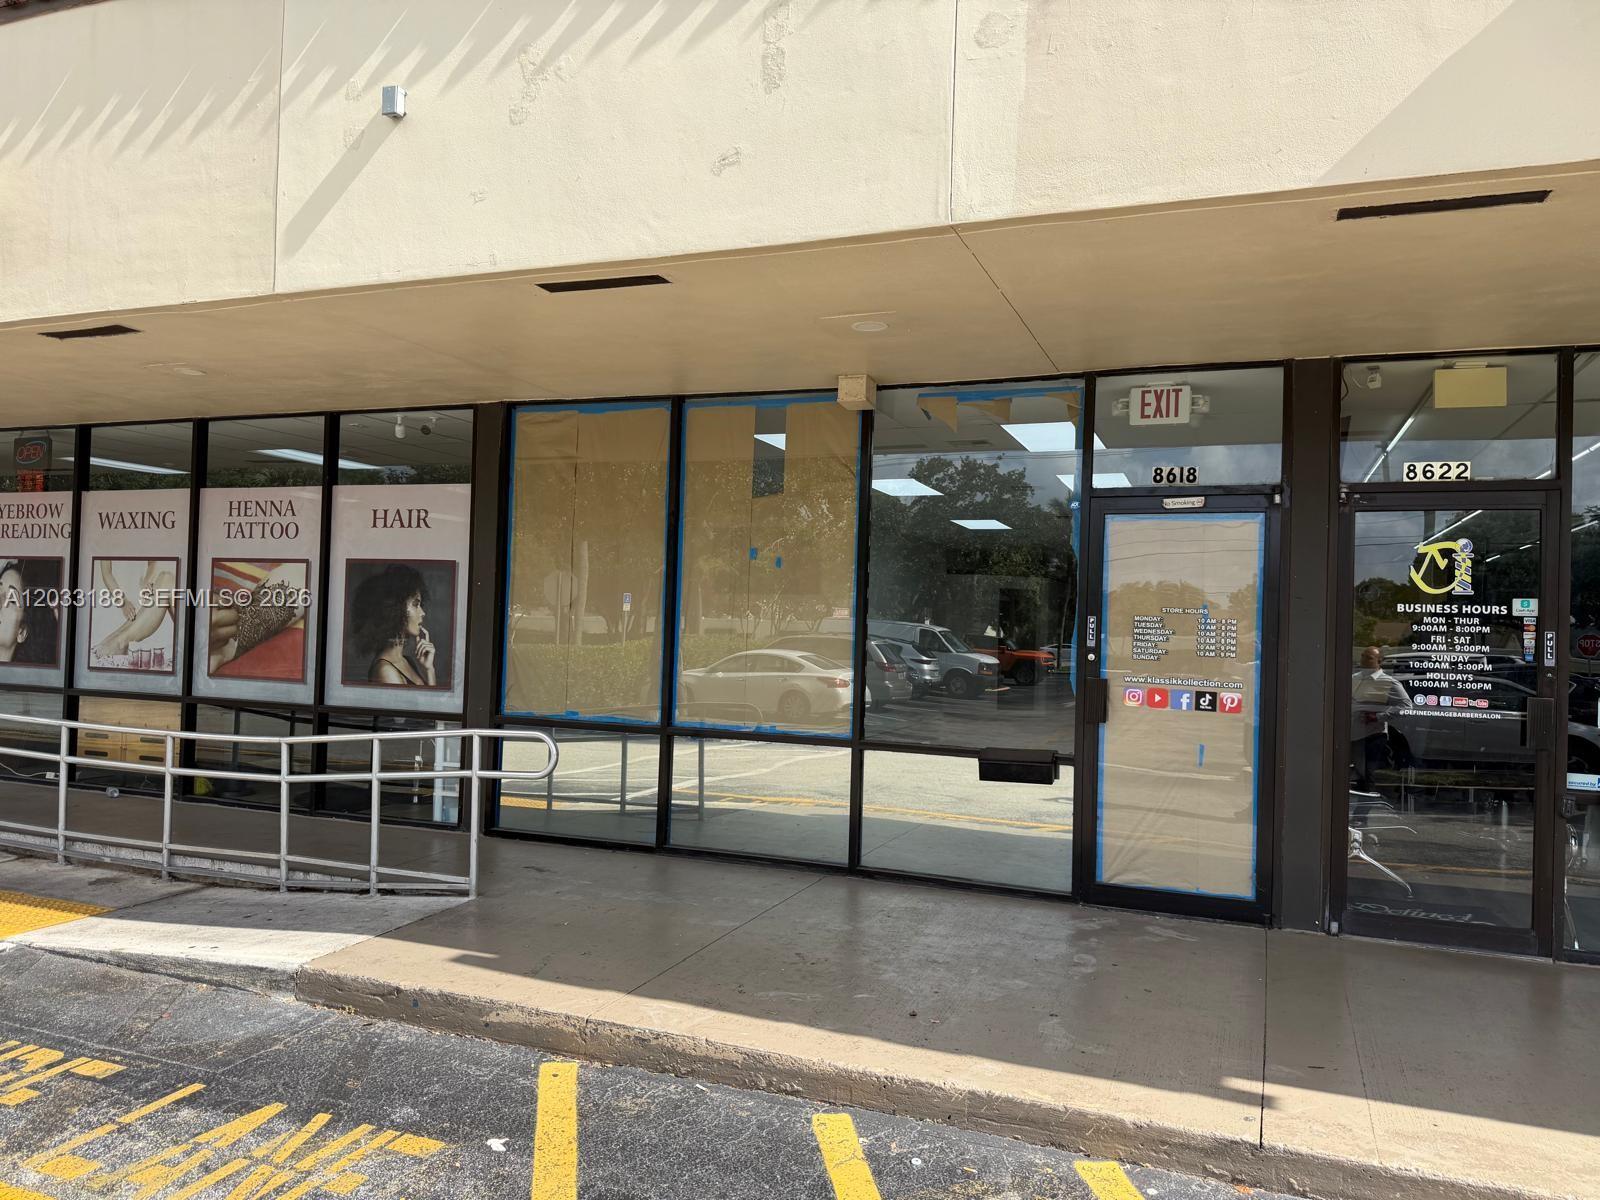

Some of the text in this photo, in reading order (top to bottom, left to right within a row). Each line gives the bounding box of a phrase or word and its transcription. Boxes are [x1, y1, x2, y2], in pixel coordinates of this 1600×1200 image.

[1139, 387, 1183, 420] EXIT
[1152, 466, 1198, 484] 8618
[1405, 462, 1469, 481] 8622
[228, 499, 297, 517] HENNA
[1171, 499, 1195, 508] Smoking
[97, 510, 176, 530] WAXING
[370, 507, 432, 529] HAIR
[223, 521, 300, 540] TATTOO
[1396, 603, 1508, 615] BUSINESS HOURS
[1423, 616, 1446, 624] MON
[1453, 617, 1480, 625] THUR
[1412, 624, 1447, 632] 9:00AM
[1455, 625, 1491, 633] 8:00PM
[1430, 635, 1446, 643] FRI
[1453, 636, 1471, 644] SAT
[1411, 643, 1447, 651] 9:00AM
[1455, 644, 1490, 653] 9:00PM
[1431, 654, 1470, 663] SUNDAY
[1409, 661, 1449, 669] 10:00AM
[1457, 663, 1492, 671] 5:00PM
[1123, 675, 1244, 689] www.klassikkollection.com
[1426, 672, 1474, 681] HOLIDAYS
[1409, 679, 1449, 688] 10:00AM
[1457, 681, 1492, 690] 5:00PM
[1399, 709, 1501, 719] @DEFINEDIMAGEBARBERSALON
[24, 1083, 446, 1200] LANE
